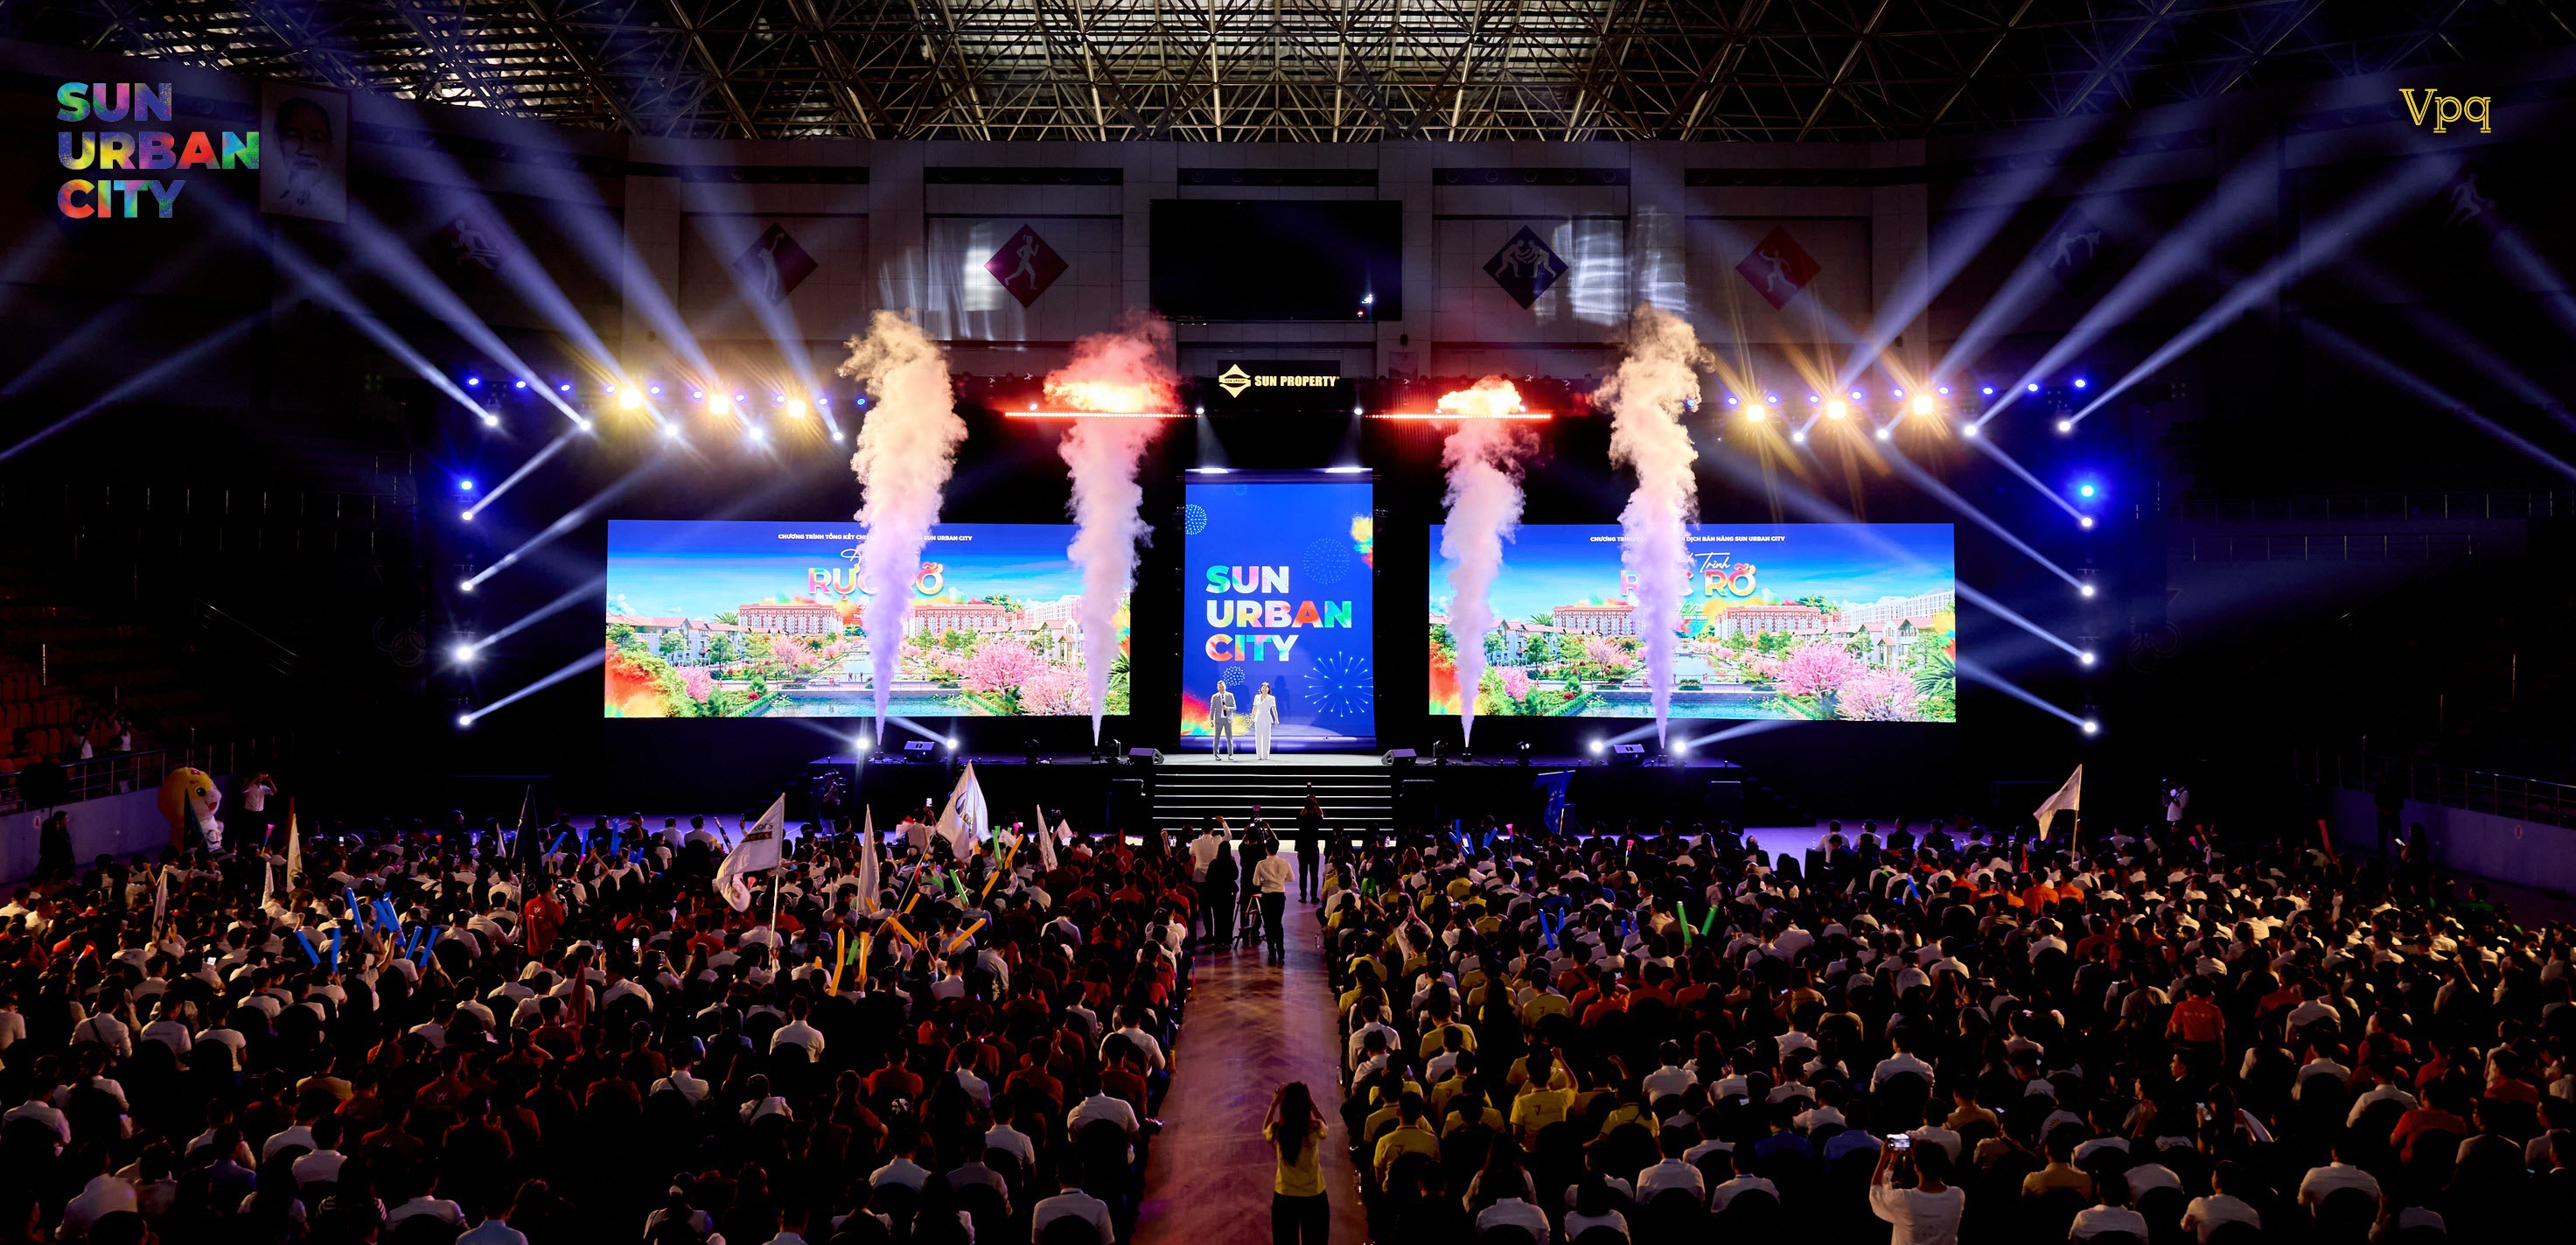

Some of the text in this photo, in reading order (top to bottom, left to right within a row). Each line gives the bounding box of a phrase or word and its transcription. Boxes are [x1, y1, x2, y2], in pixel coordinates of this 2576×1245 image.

[1254, 375, 1277, 387] SUN
[1205, 564, 1289, 594] SUN
[1205, 599, 1352, 628] URBAN
[1204, 633, 1300, 662] CITY
